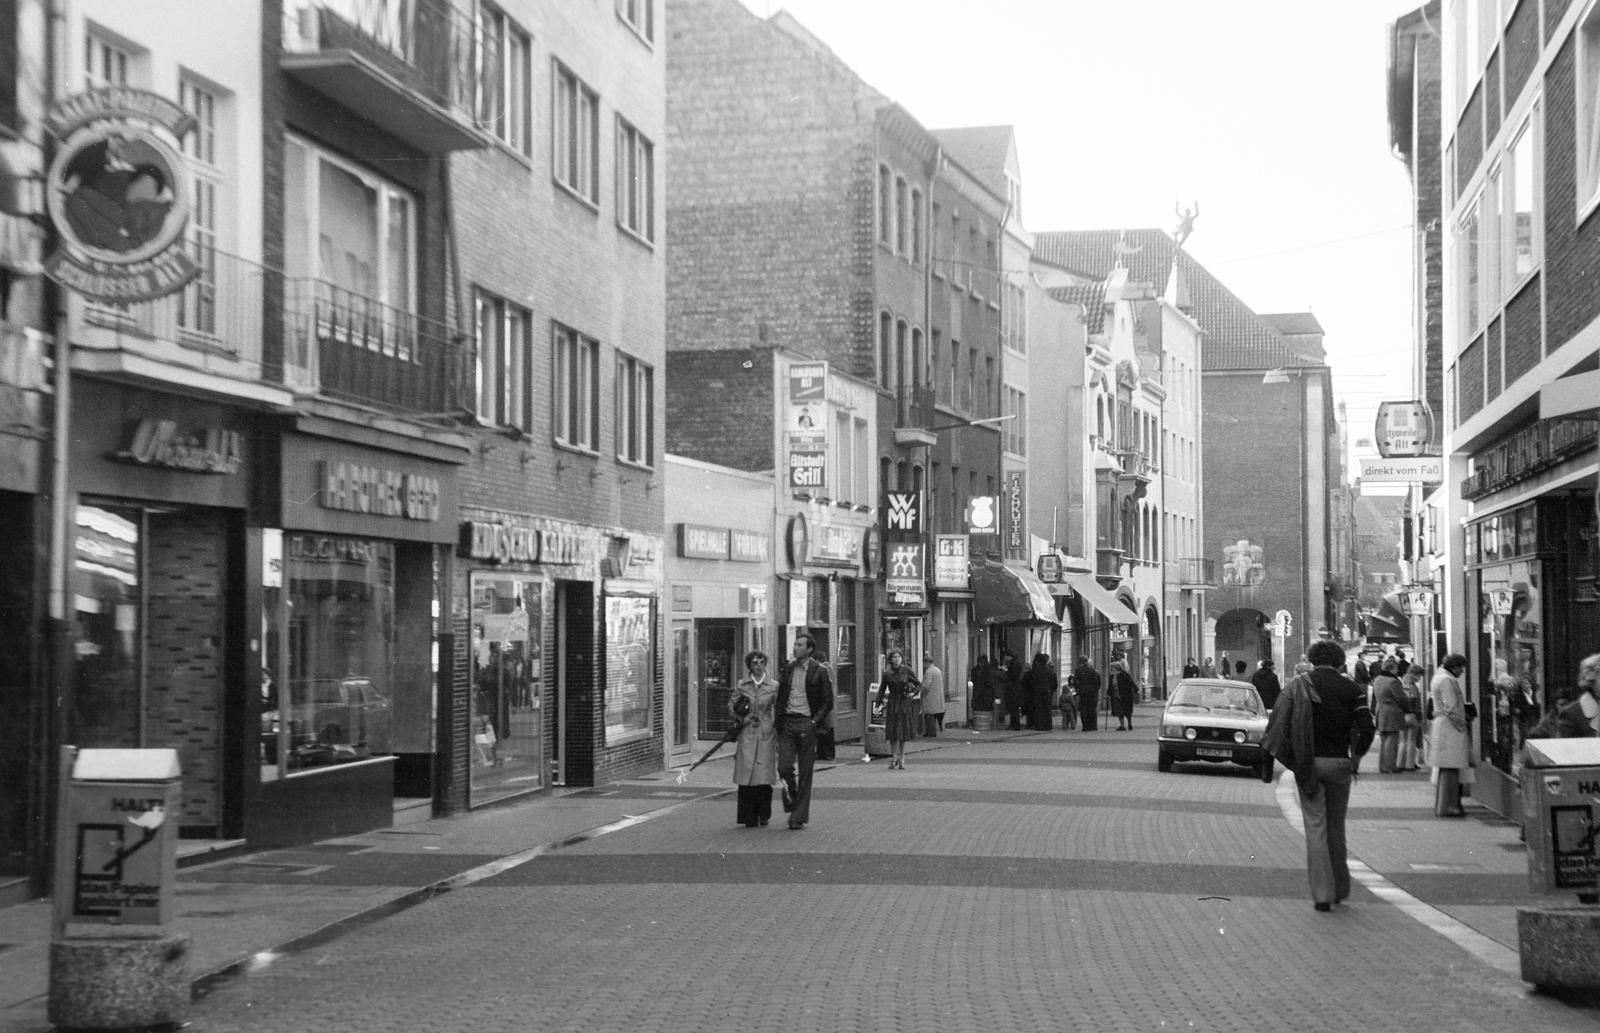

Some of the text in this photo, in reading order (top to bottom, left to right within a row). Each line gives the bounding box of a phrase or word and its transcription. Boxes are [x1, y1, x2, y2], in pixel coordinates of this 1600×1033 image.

[793, 467, 821, 485] Grill
[1365, 464, 1440, 476] direkt vom Faß
[1011, 472, 1021, 547] FISCHKUTTER
[472, 522, 538, 564] EDUSCHO
